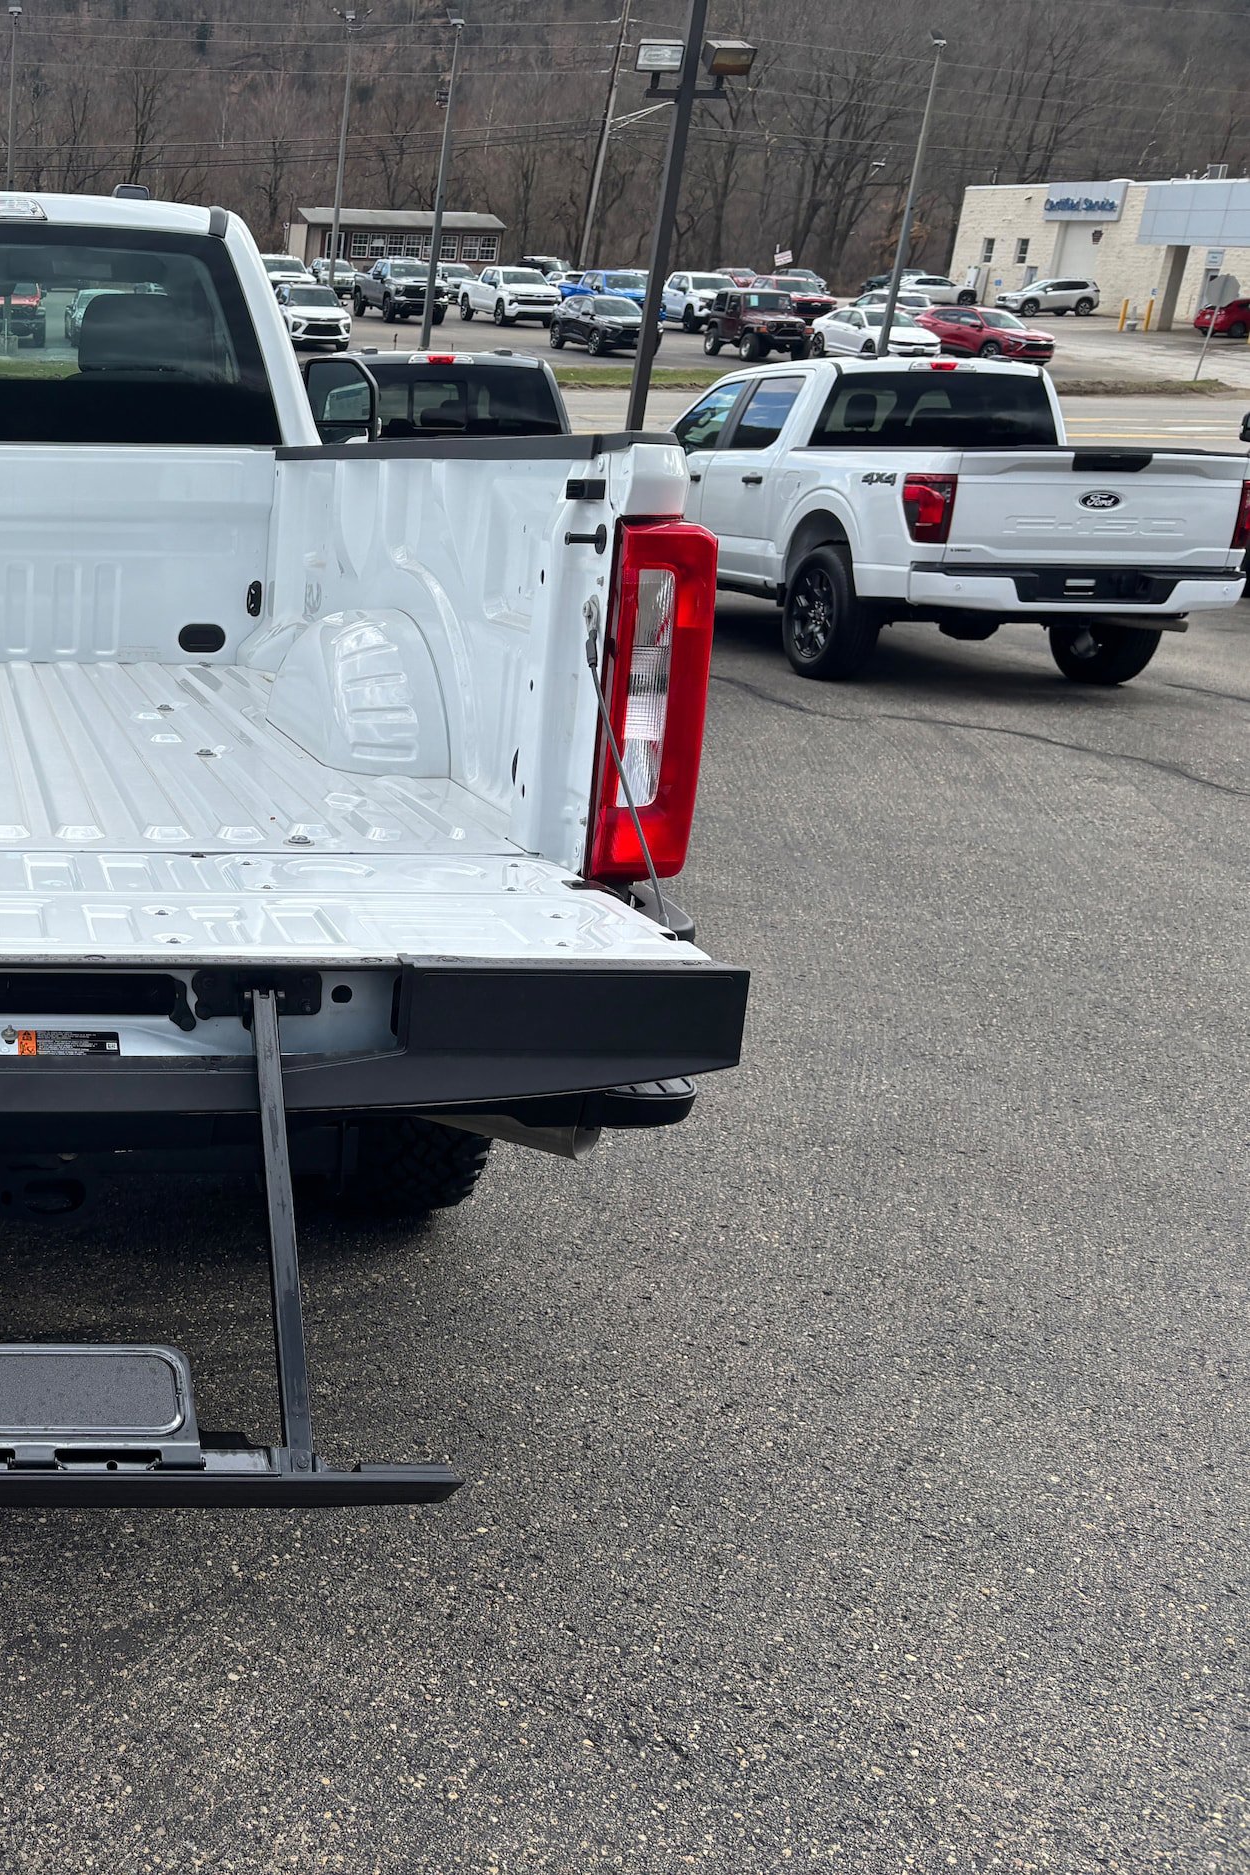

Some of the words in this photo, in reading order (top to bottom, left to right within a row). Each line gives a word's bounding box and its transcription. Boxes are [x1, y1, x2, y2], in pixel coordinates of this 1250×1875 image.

[1045, 198, 1082, 212] Certified
[1082, 198, 1118, 212] Service
[1085, 493, 1117, 508] Ford
[1002, 515, 1187, 536] F-150
